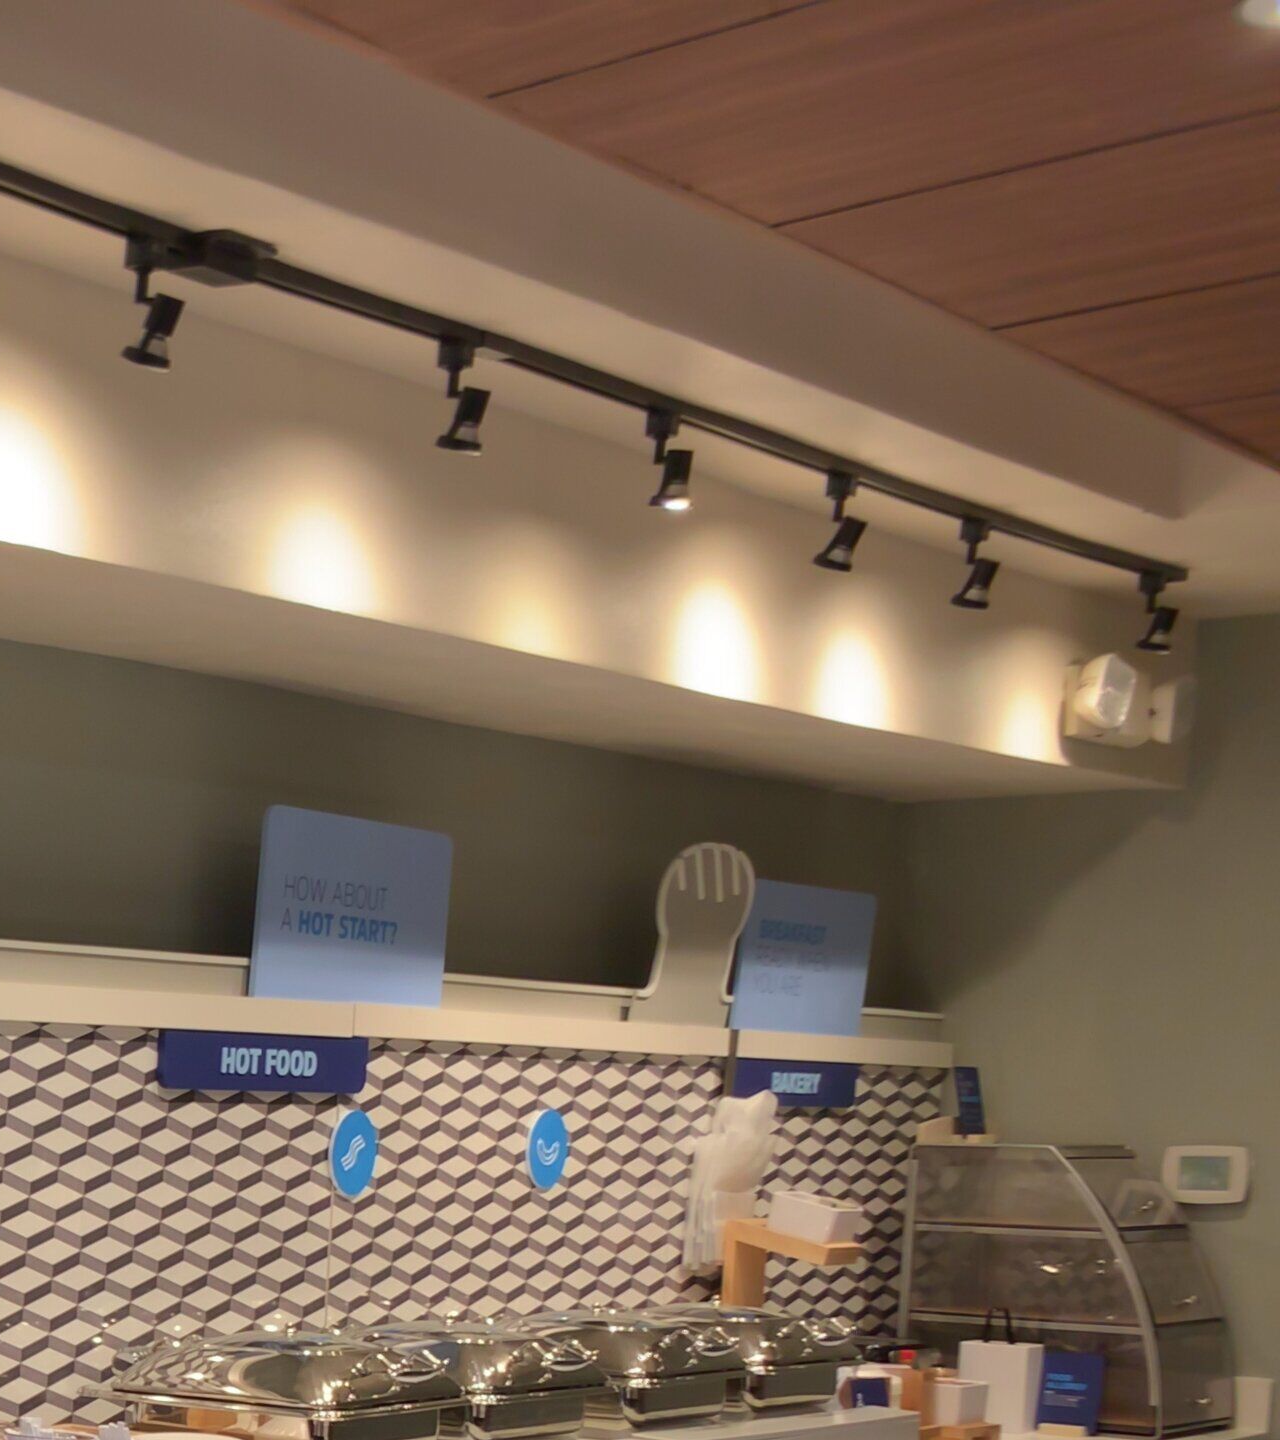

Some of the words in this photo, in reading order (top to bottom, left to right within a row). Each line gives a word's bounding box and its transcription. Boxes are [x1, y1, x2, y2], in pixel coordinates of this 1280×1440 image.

[282, 872, 328, 903] HOW
[332, 880, 390, 911] ABOUT
[280, 906, 293, 932] A
[297, 909, 335, 937] HOT
[337, 914, 399, 945] START?
[220, 1046, 263, 1076] HOT
[264, 1048, 318, 1078] FOOD
[770, 1070, 822, 1096] BAKERY
